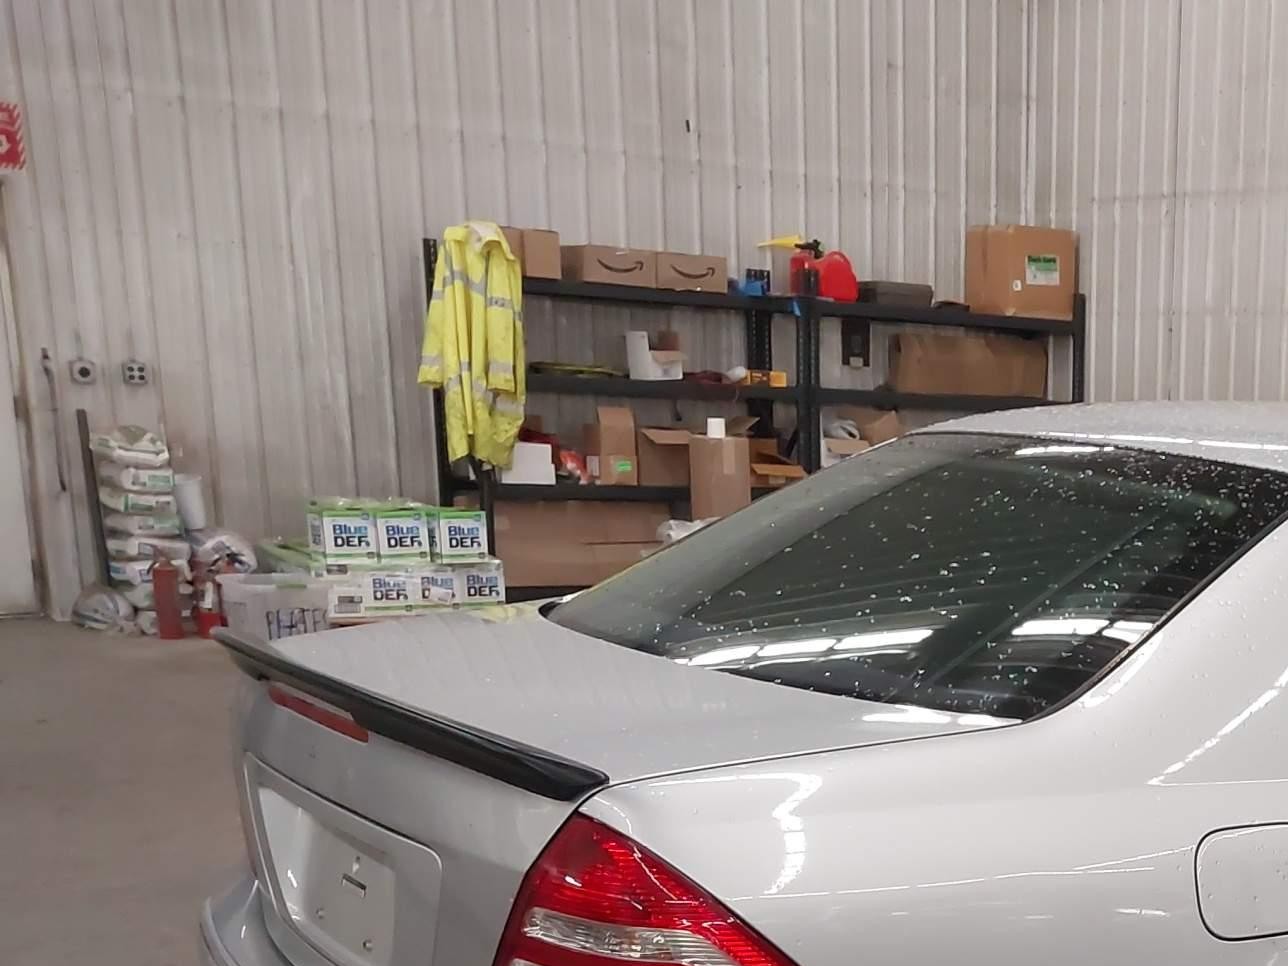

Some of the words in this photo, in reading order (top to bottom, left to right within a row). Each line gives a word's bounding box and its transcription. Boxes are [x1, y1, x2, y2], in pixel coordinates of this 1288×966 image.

[332, 524, 368, 535] Blue
[385, 524, 420, 536] Blue
[448, 525, 480, 536] Blue
[333, 535, 370, 548] DEF
[387, 536, 422, 548] DEF
[449, 536, 482, 548] DEF
[372, 577, 406, 589] Blue
[421, 576, 454, 588] Blue
[466, 574, 498, 586] Blue
[373, 588, 409, 600] DEF
[467, 586, 500, 597] DEF
